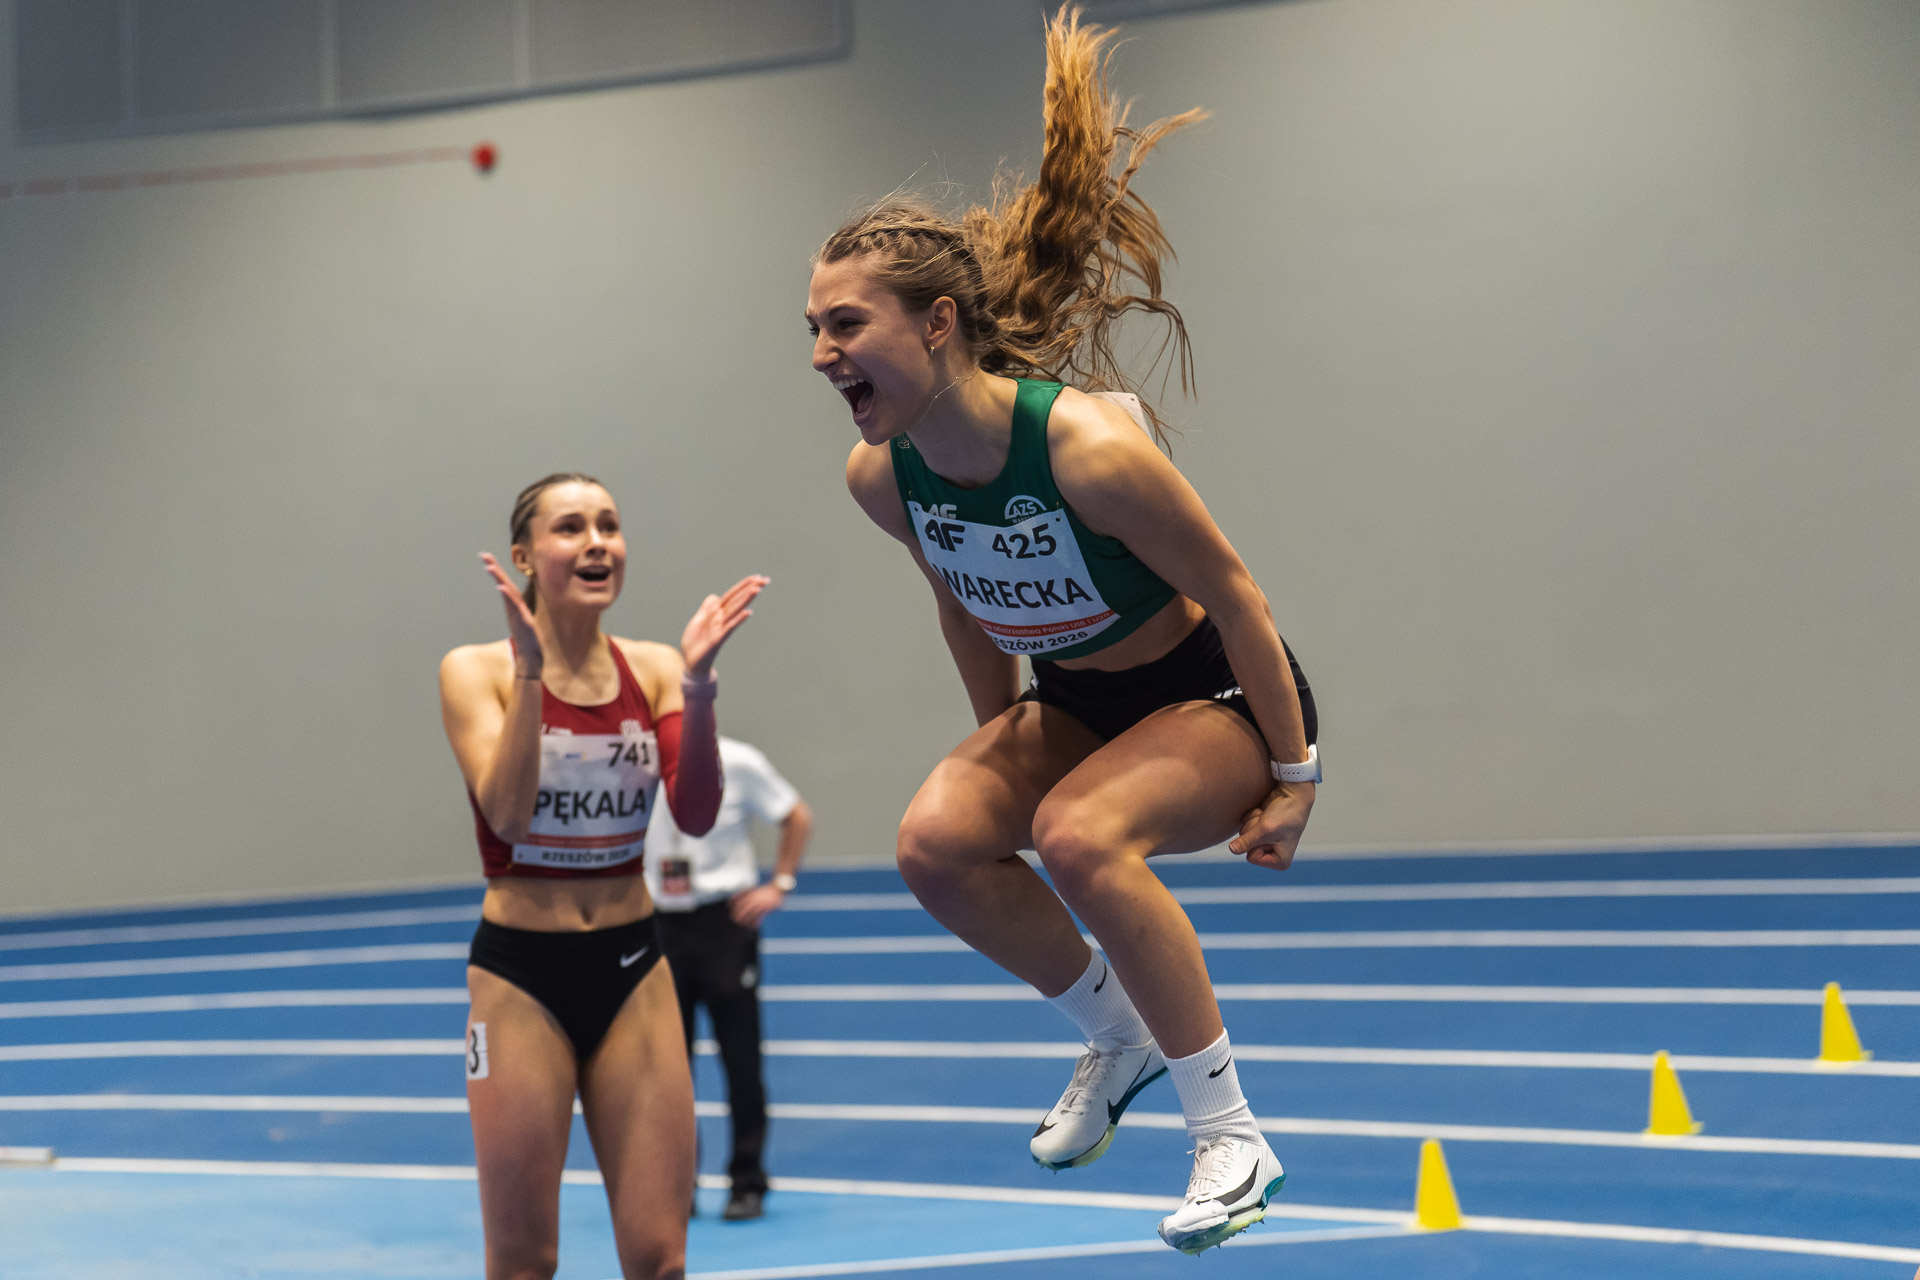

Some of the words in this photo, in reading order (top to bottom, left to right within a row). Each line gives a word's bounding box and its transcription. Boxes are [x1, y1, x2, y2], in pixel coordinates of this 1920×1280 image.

[1009, 501, 1037, 518] AZS
[992, 523, 1057, 559] 425
[932, 563, 1094, 609] WARECKA
[1042, 623, 1069, 633] Polski
[1070, 619, 1087, 628] U18
[1047, 631, 1088, 647] 2026
[607, 742, 650, 767] 741
[534, 788, 647, 826] PĘKALA
[468, 1029, 480, 1074] 3
